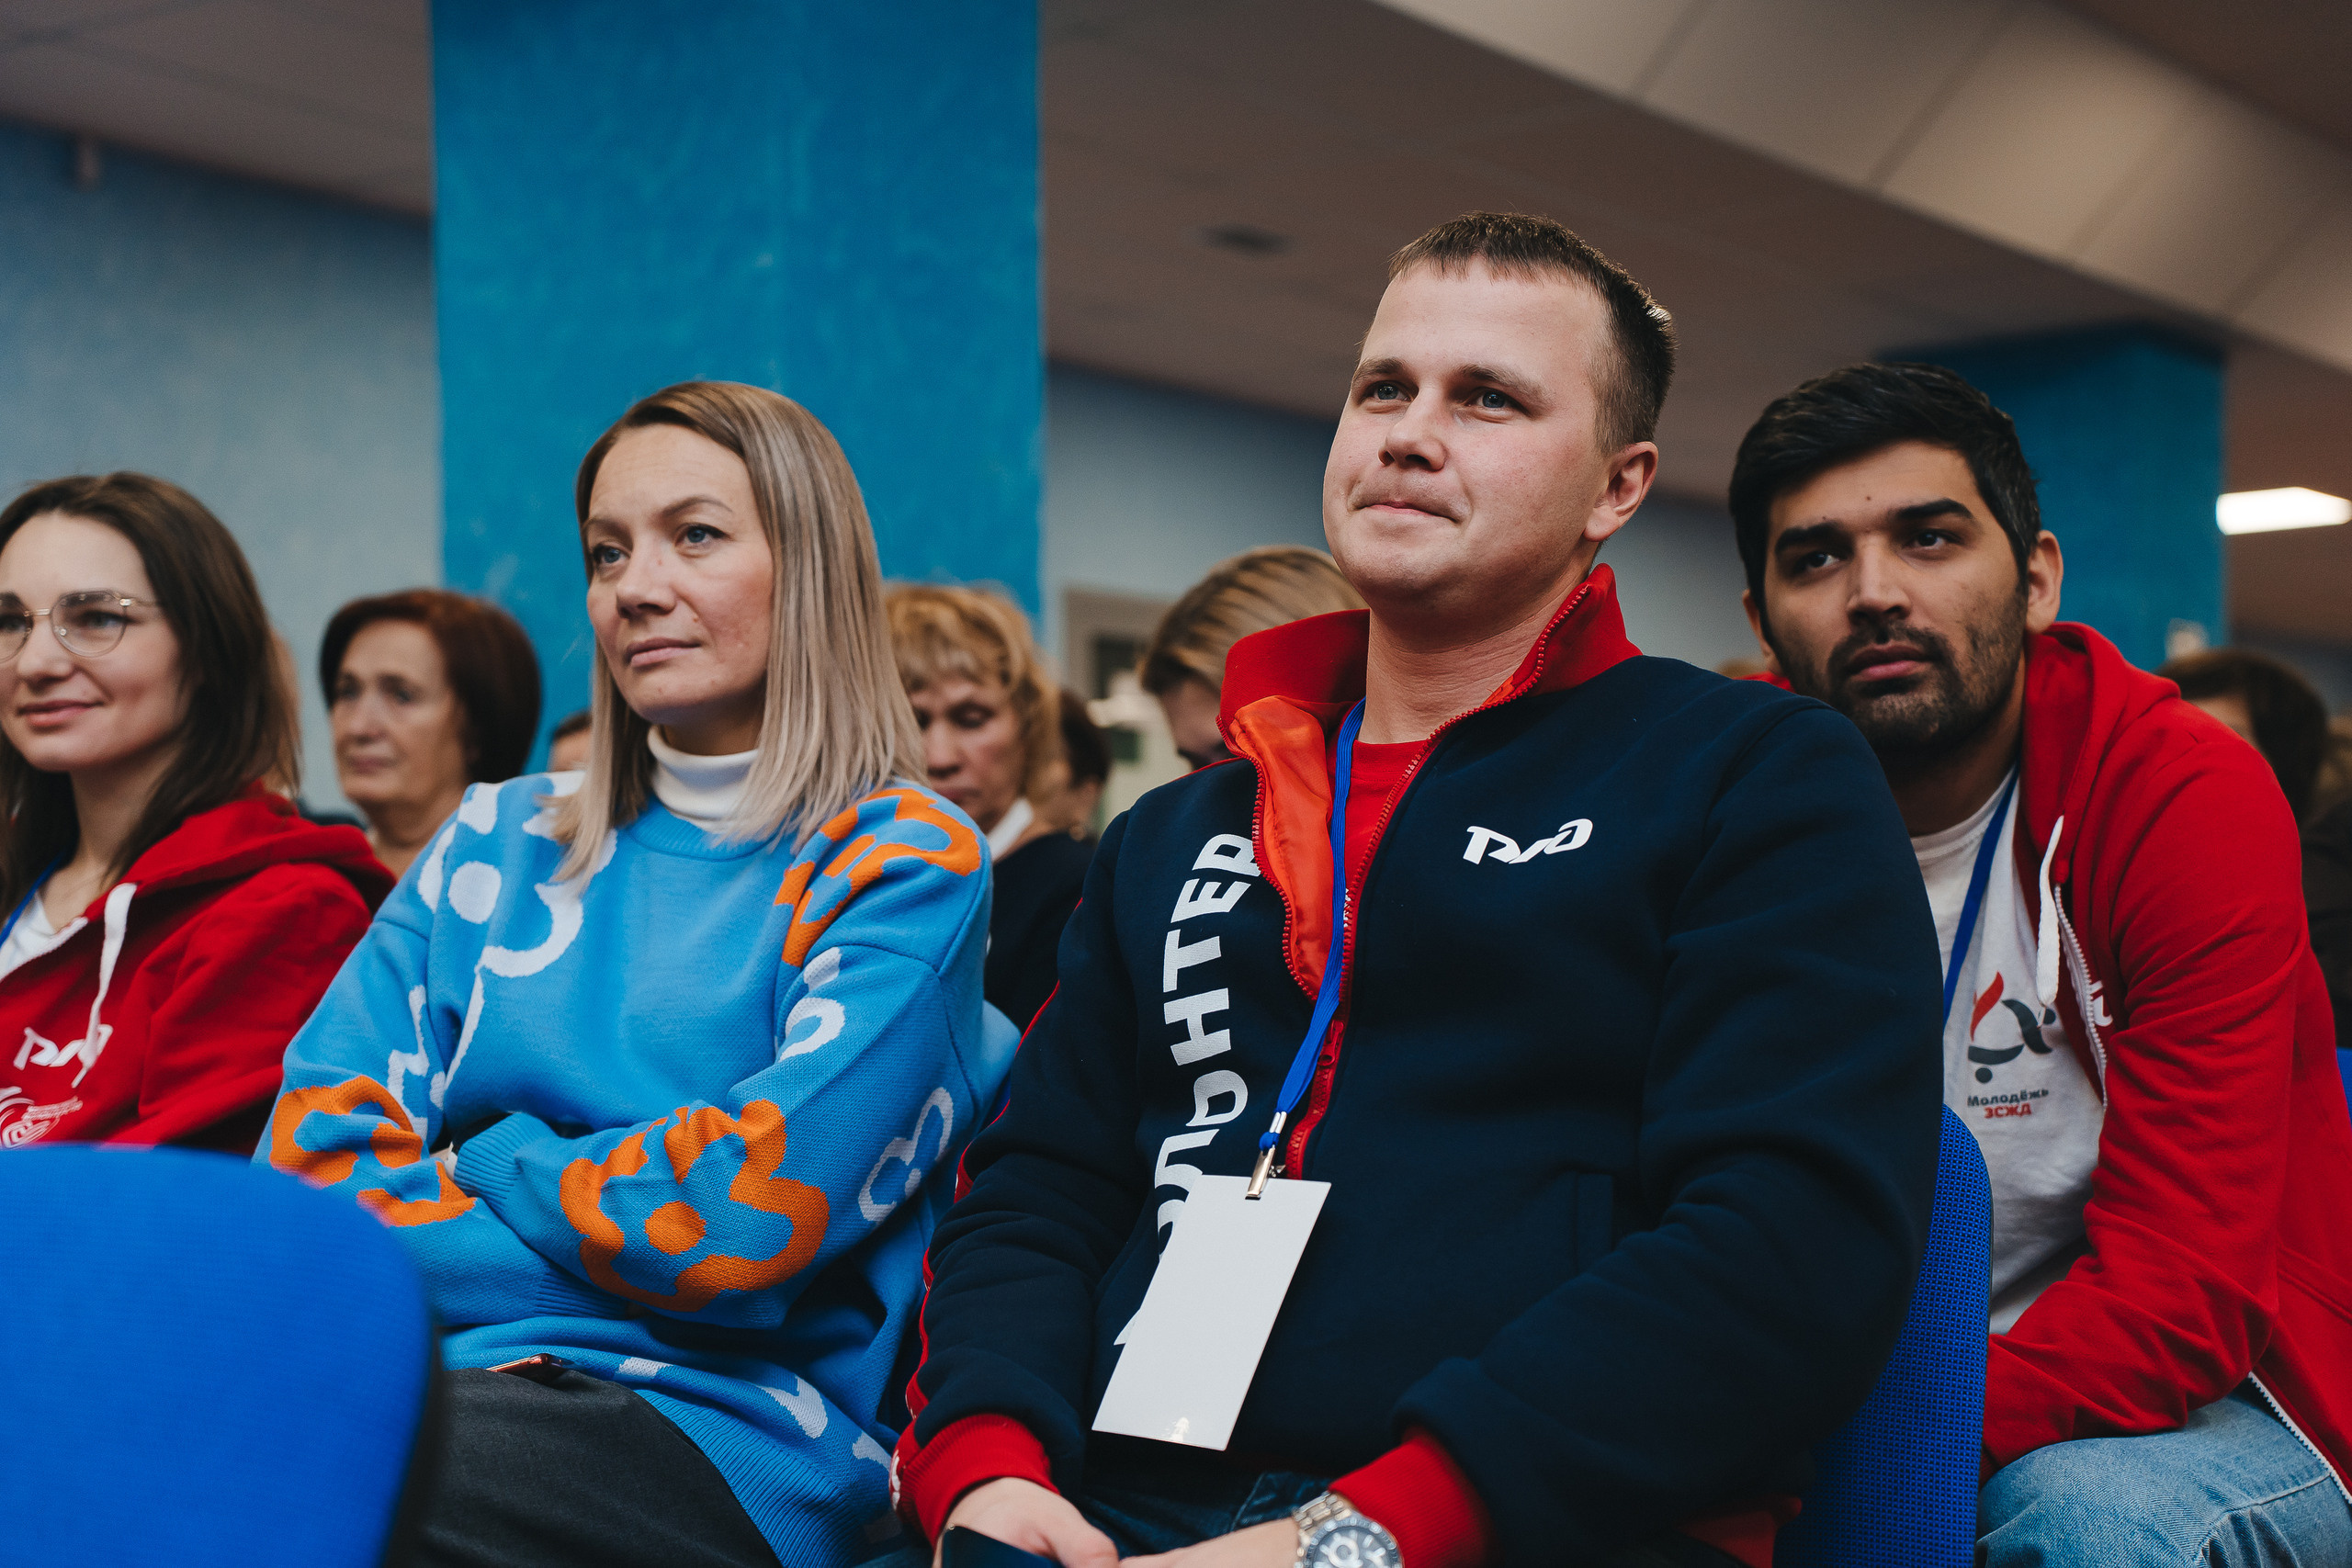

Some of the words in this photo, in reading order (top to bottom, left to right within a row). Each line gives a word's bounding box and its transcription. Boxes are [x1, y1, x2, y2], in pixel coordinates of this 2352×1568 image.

[1113, 833, 1261, 1346] ЛОНТЕР
[1967, 1089, 2049, 1107] Молодёжь
[1984, 1102, 2032, 1119] ЗСЖД
